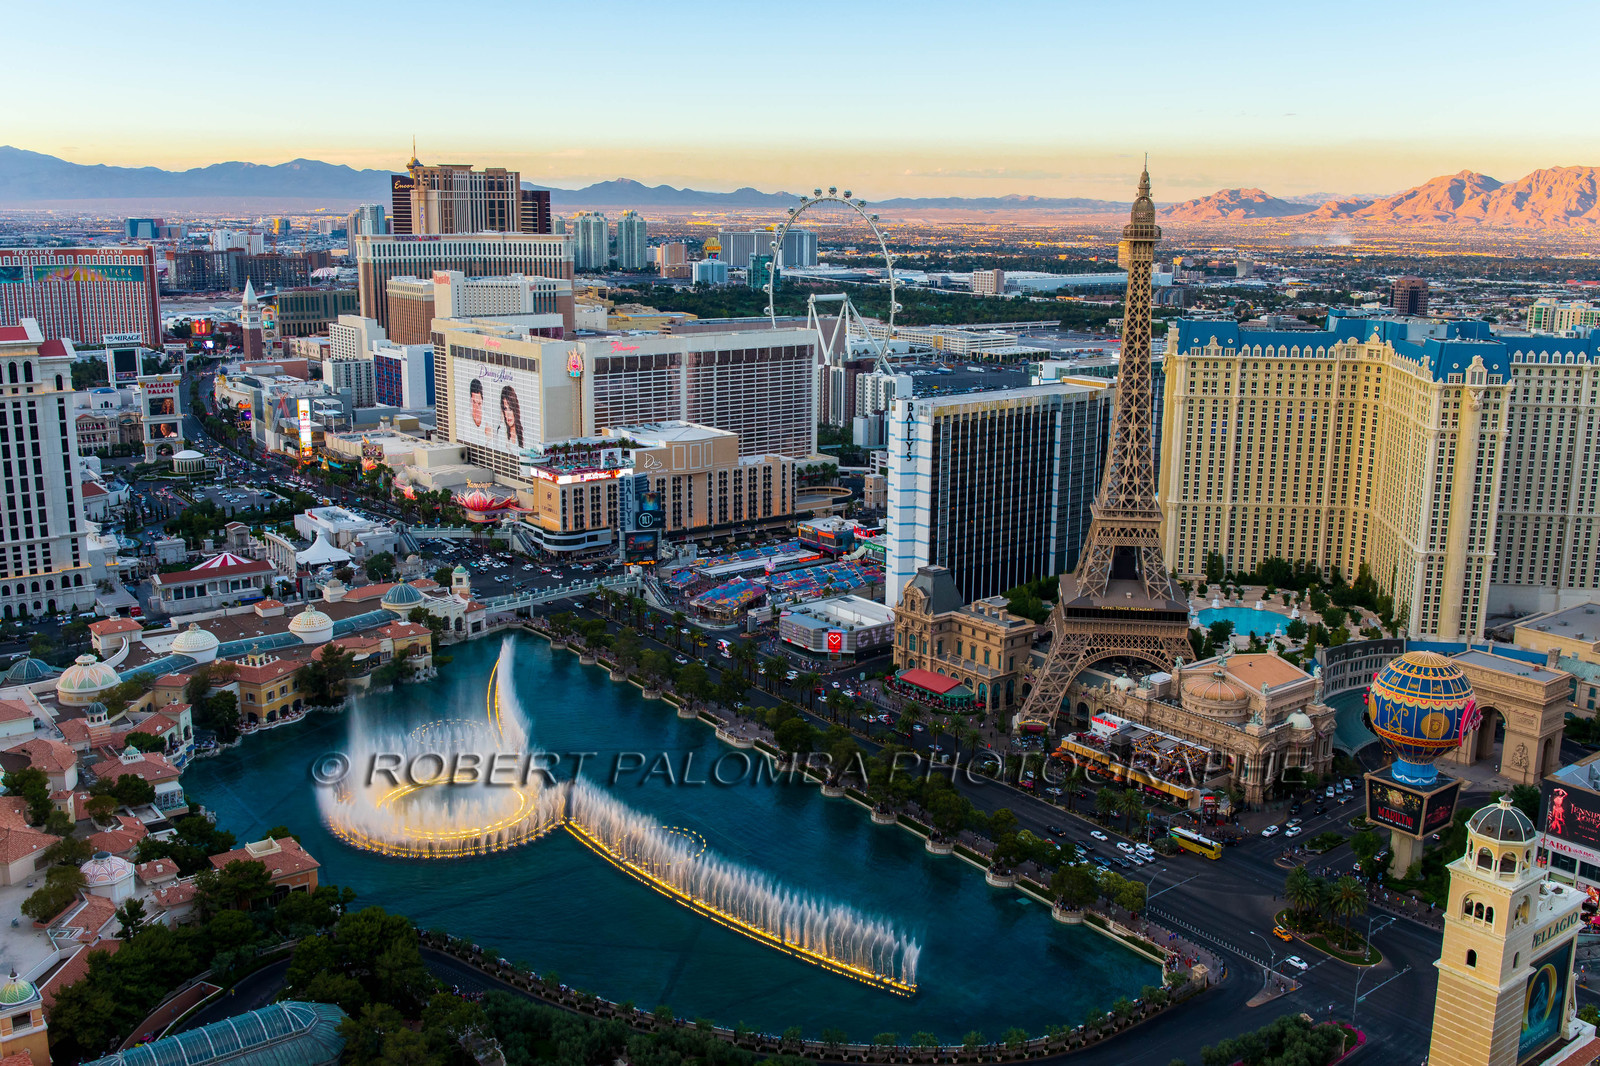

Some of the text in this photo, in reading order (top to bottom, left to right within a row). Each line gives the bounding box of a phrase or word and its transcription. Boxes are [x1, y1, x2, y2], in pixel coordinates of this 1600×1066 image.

[394, 180, 415, 189] Encore
[194, 319, 207, 335] ti
[113, 334, 141, 342] MIRAGE
[857, 624, 895, 648] CVS
[1540, 838, 1572, 852] CABO
